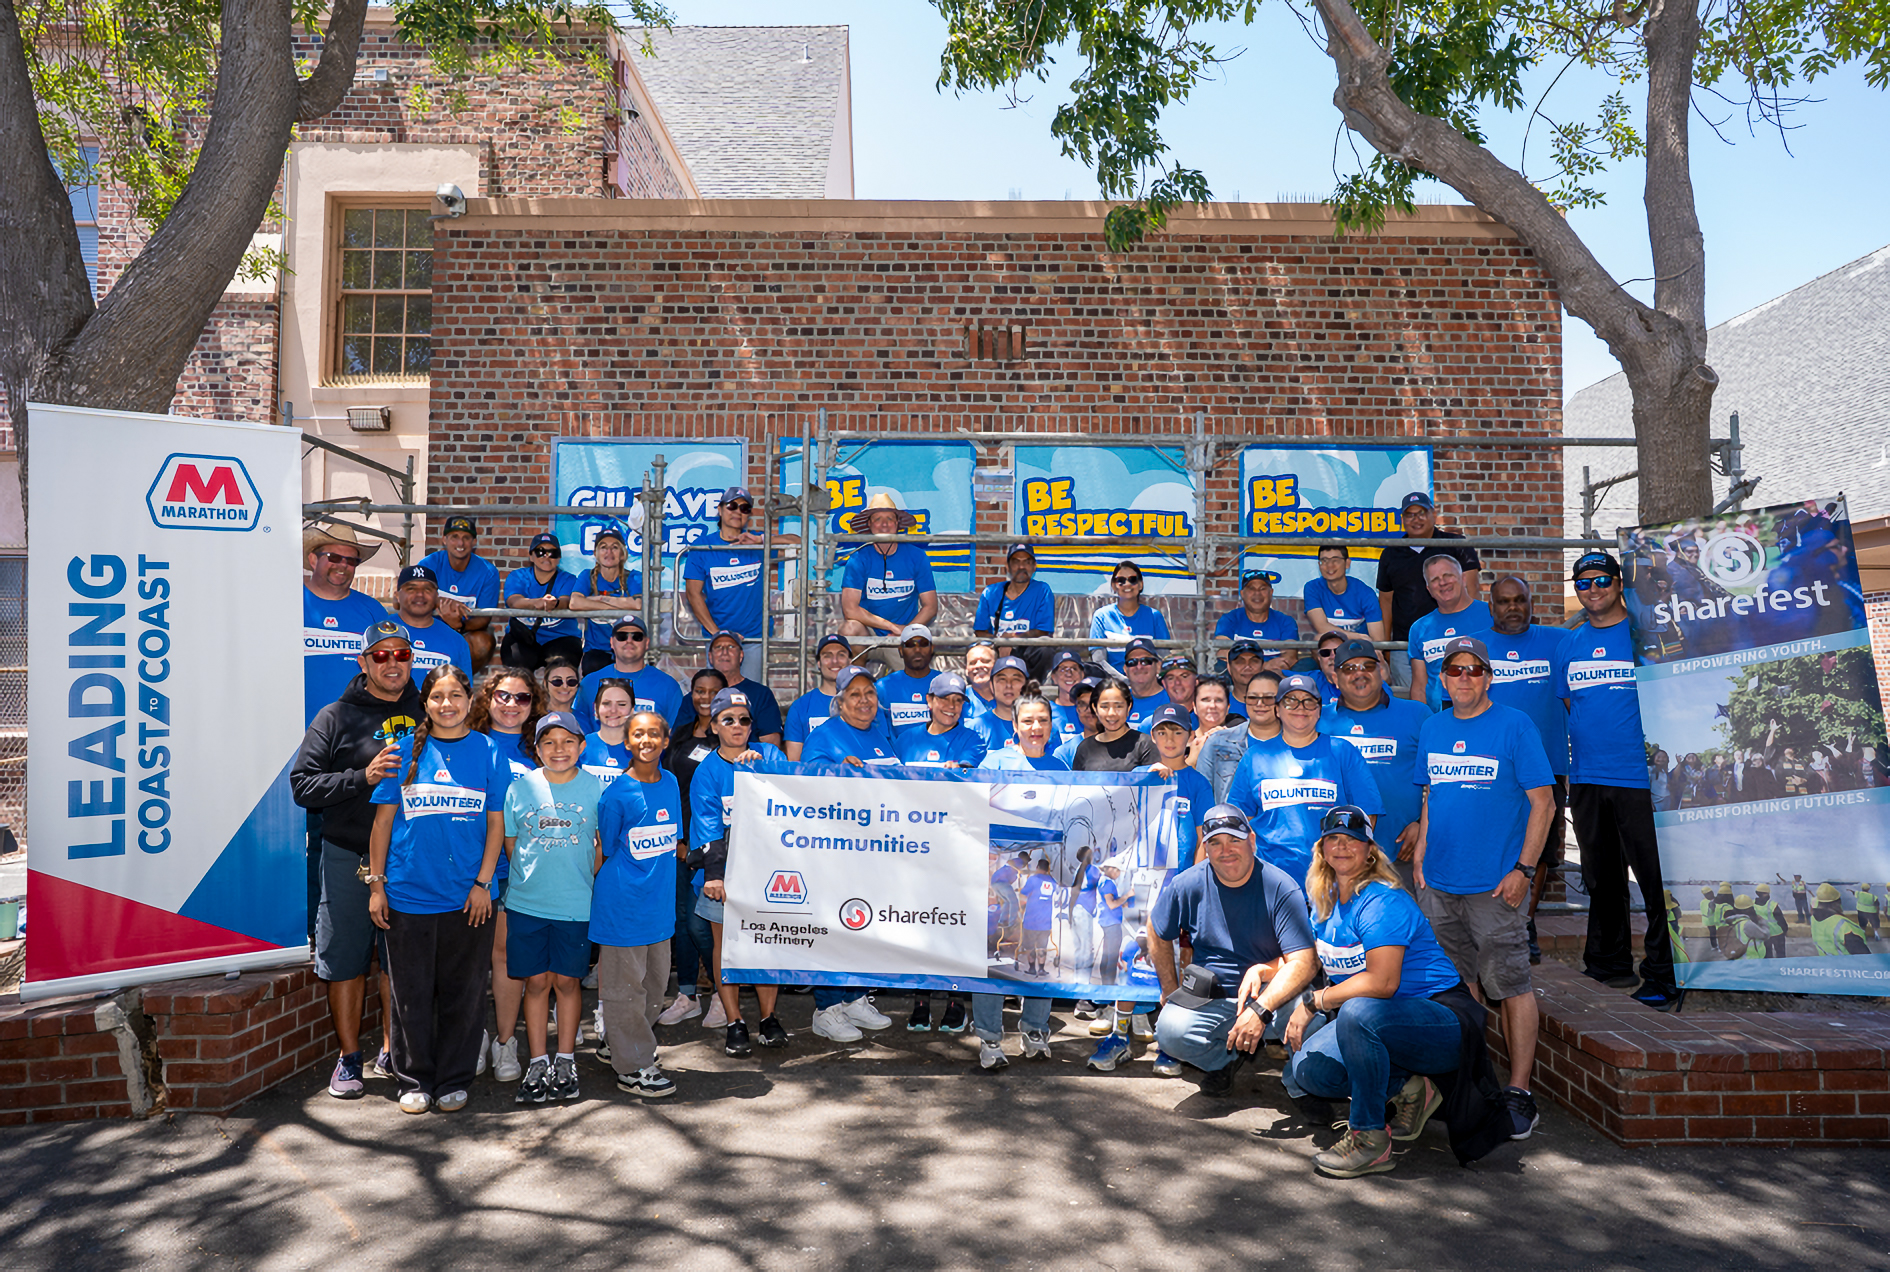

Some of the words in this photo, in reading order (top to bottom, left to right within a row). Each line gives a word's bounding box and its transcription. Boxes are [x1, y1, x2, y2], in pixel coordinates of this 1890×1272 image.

[825, 479, 863, 510] BE
[1027, 480, 1072, 512] BE
[1253, 478, 1295, 509] BE
[161, 505, 249, 521] MARATHON
[1027, 512, 1189, 537] RESPECTFUL
[1252, 511, 1406, 534] RESPONSIBL
[1654, 580, 1831, 624] sharefest
[138, 553, 171, 684] COAST
[304, 637, 362, 650] OLUNTEE
[1672, 649, 1768, 675] EMPOWERING
[1770, 639, 1827, 657] YOUTH.
[67, 552, 127, 860] LEADING
[149, 697, 159, 712] TO
[138, 721, 171, 854] COAST
[1263, 787, 1336, 801] VOLUNTEER
[405, 795, 483, 810] VOLUNTEER
[766, 798, 872, 827] Investing
[879, 803, 900, 822] in
[907, 810, 949, 824] our
[1678, 799, 1791, 823] TRANSFORMING
[1795, 792, 1871, 811] FUTURES.
[632, 833, 678, 850] VOLUNT
[780, 829, 931, 854] Communities
[741, 919, 767, 931] Los
[878, 904, 967, 926] sharefest
[754, 932, 815, 949] Refinery
